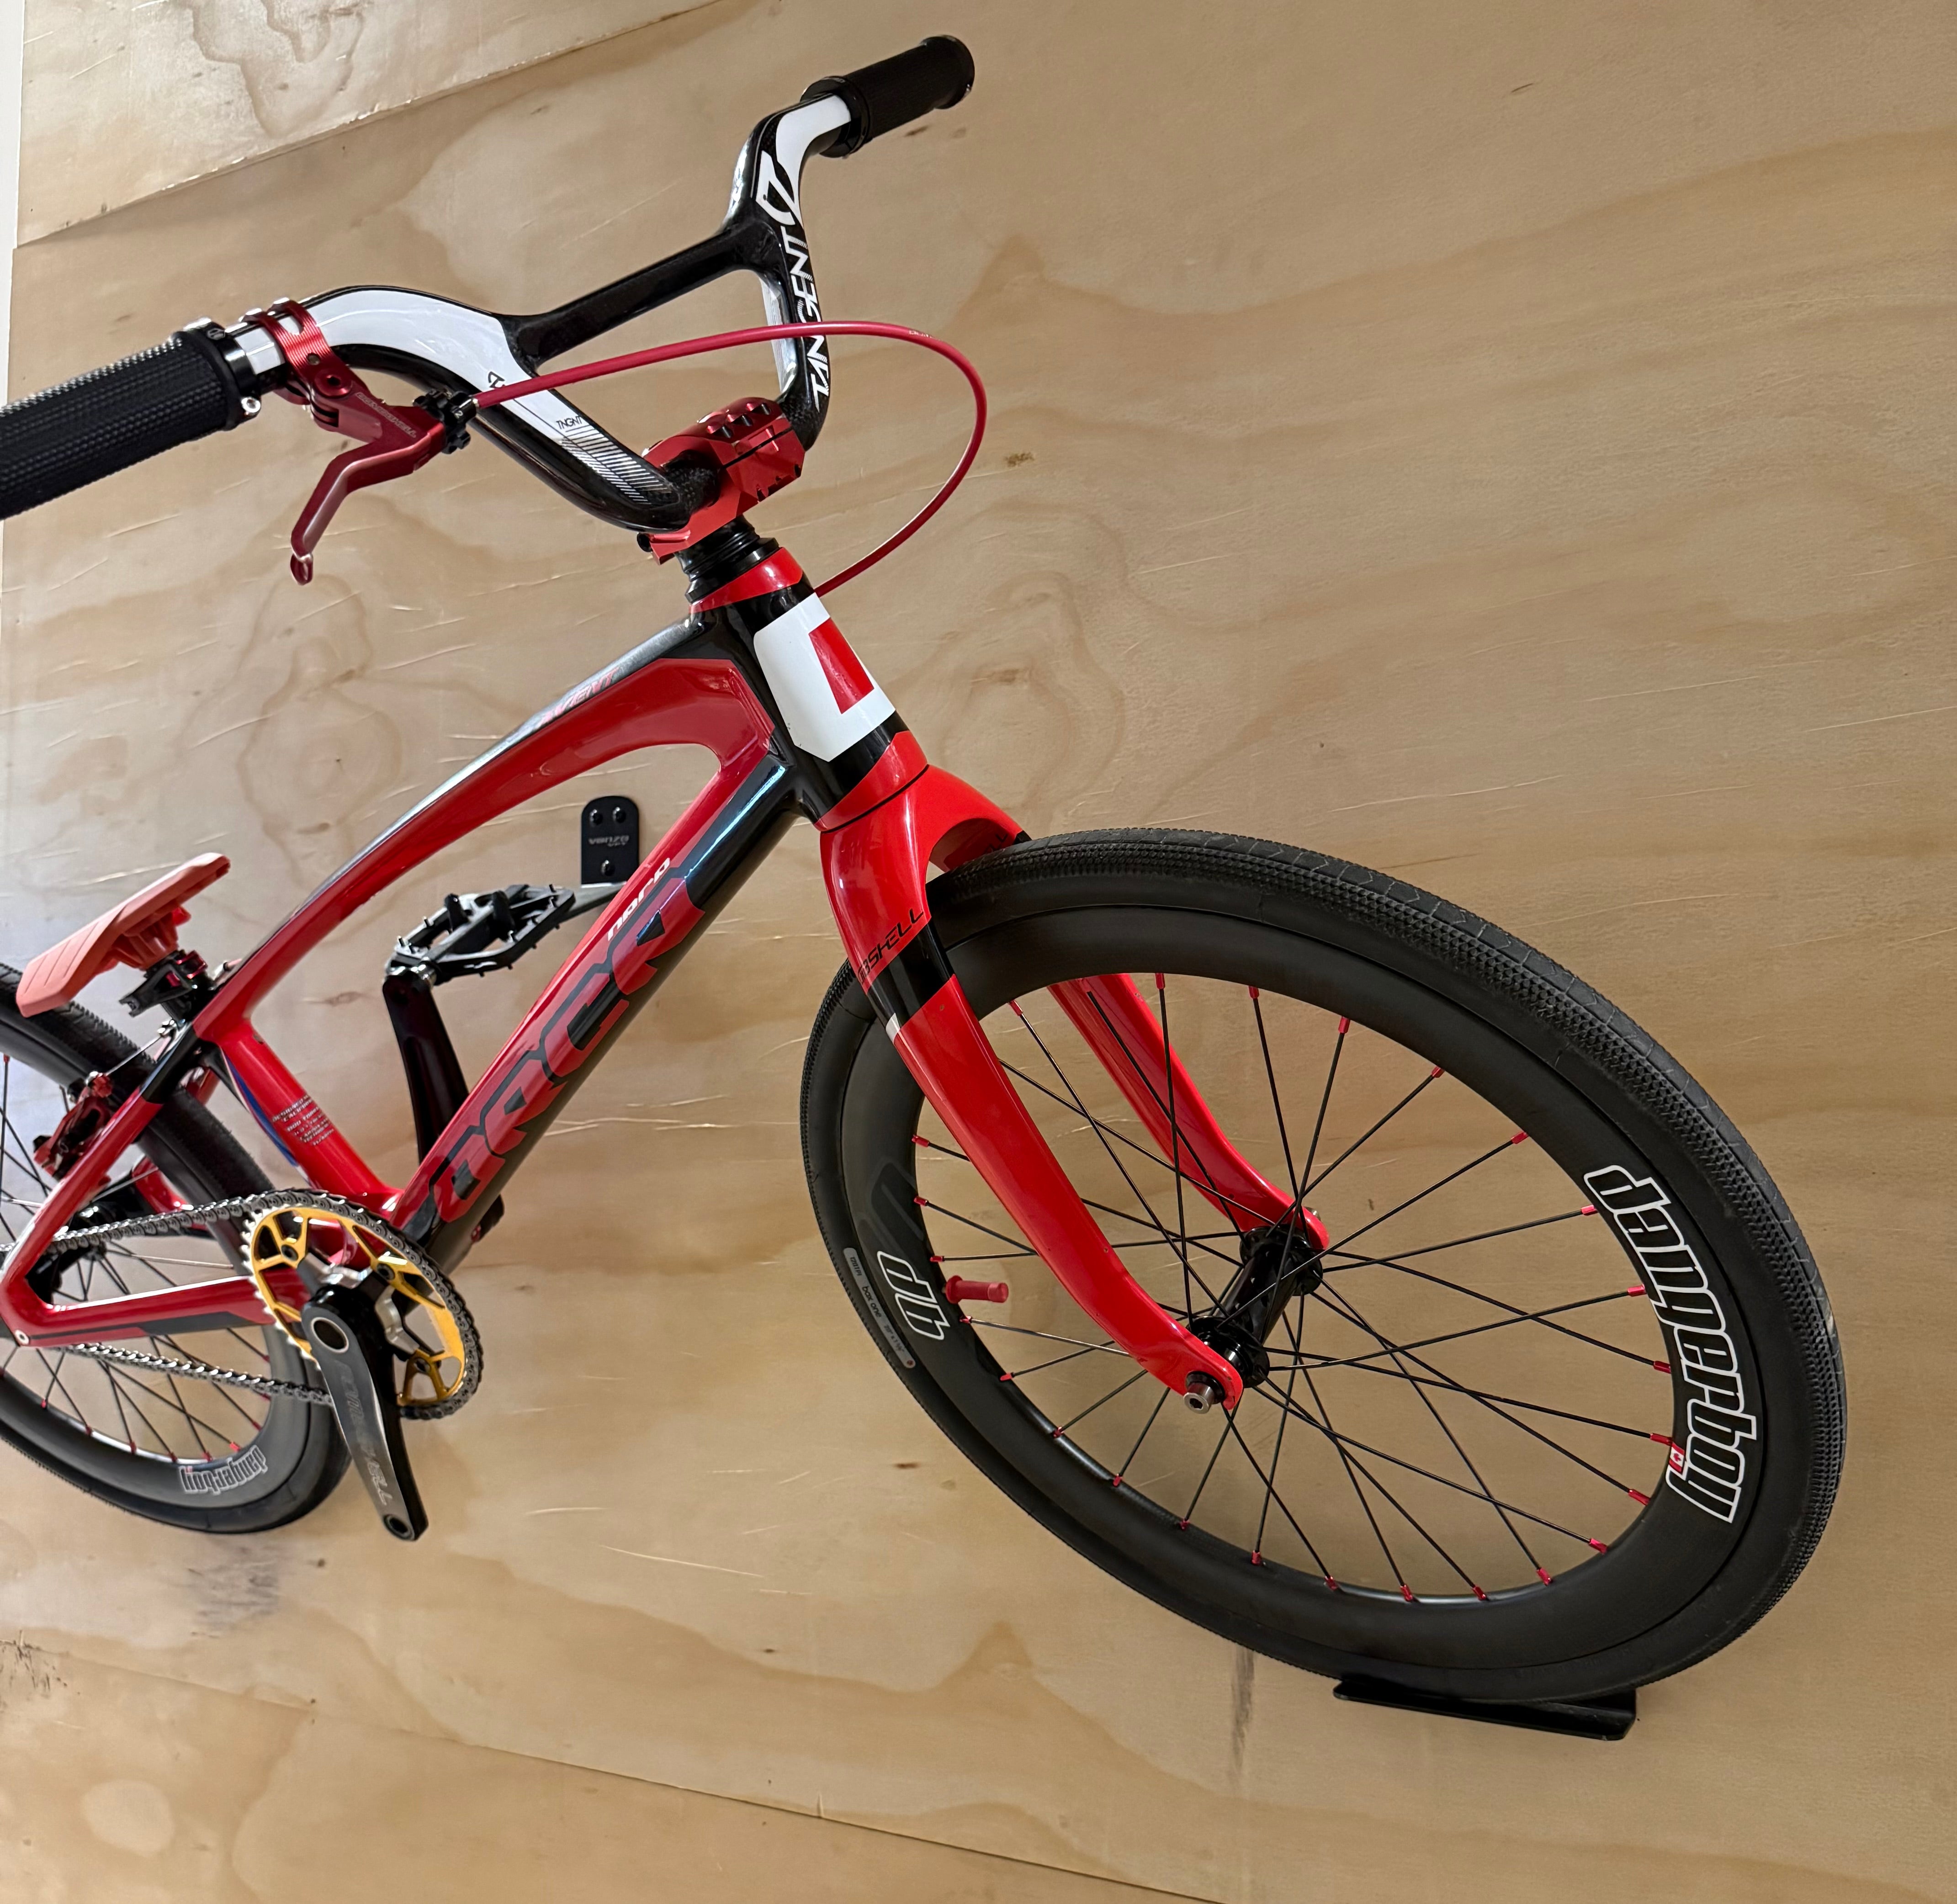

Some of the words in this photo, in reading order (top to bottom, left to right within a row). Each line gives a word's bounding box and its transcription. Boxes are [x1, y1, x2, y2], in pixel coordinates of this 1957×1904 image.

[780, 226, 829, 413] TANGENT
[556, 416, 583, 430] TNGNT
[862, 1286, 872, 1301] box
[870, 1302, 882, 1318] one
[1583, 1164, 1757, 1524] dangerboy
[179, 1444, 268, 1496] dangerboy
